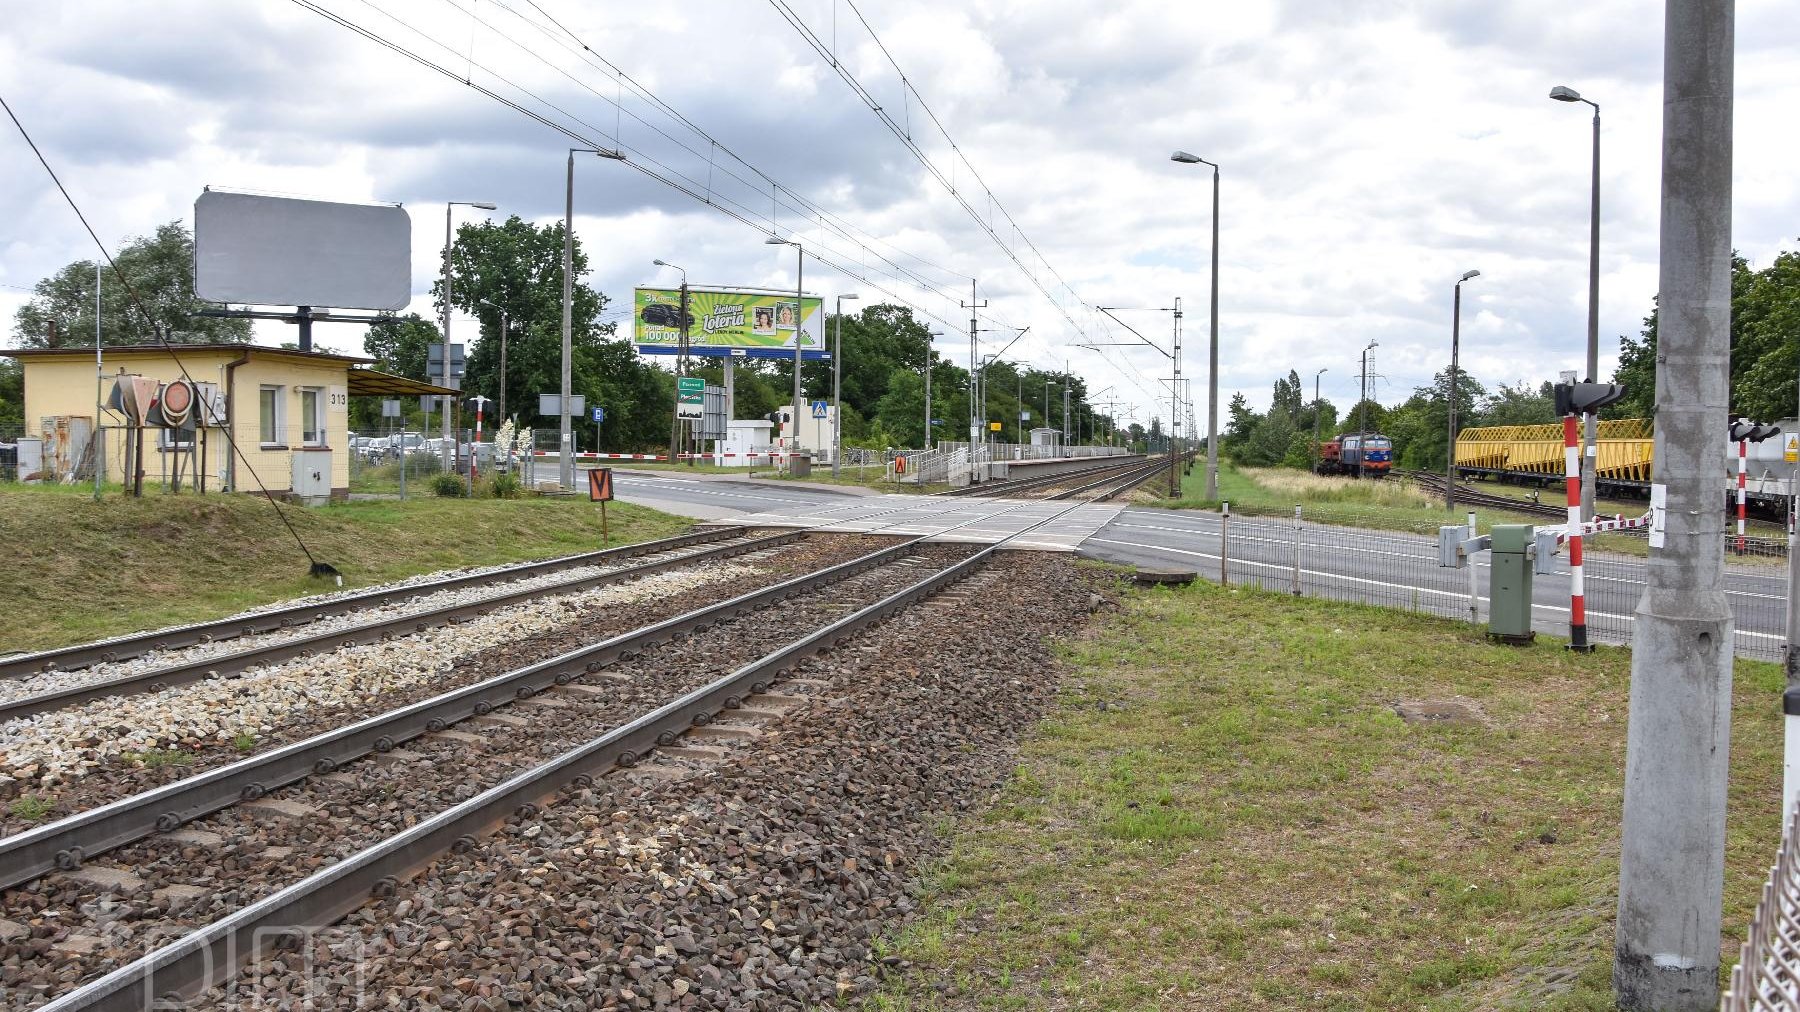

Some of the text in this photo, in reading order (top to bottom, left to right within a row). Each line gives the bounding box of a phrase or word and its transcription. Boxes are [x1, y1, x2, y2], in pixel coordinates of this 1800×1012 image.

[702, 314, 745, 334] Loteria
[645, 331, 662, 340] 100
[331, 393, 346, 405] 313
